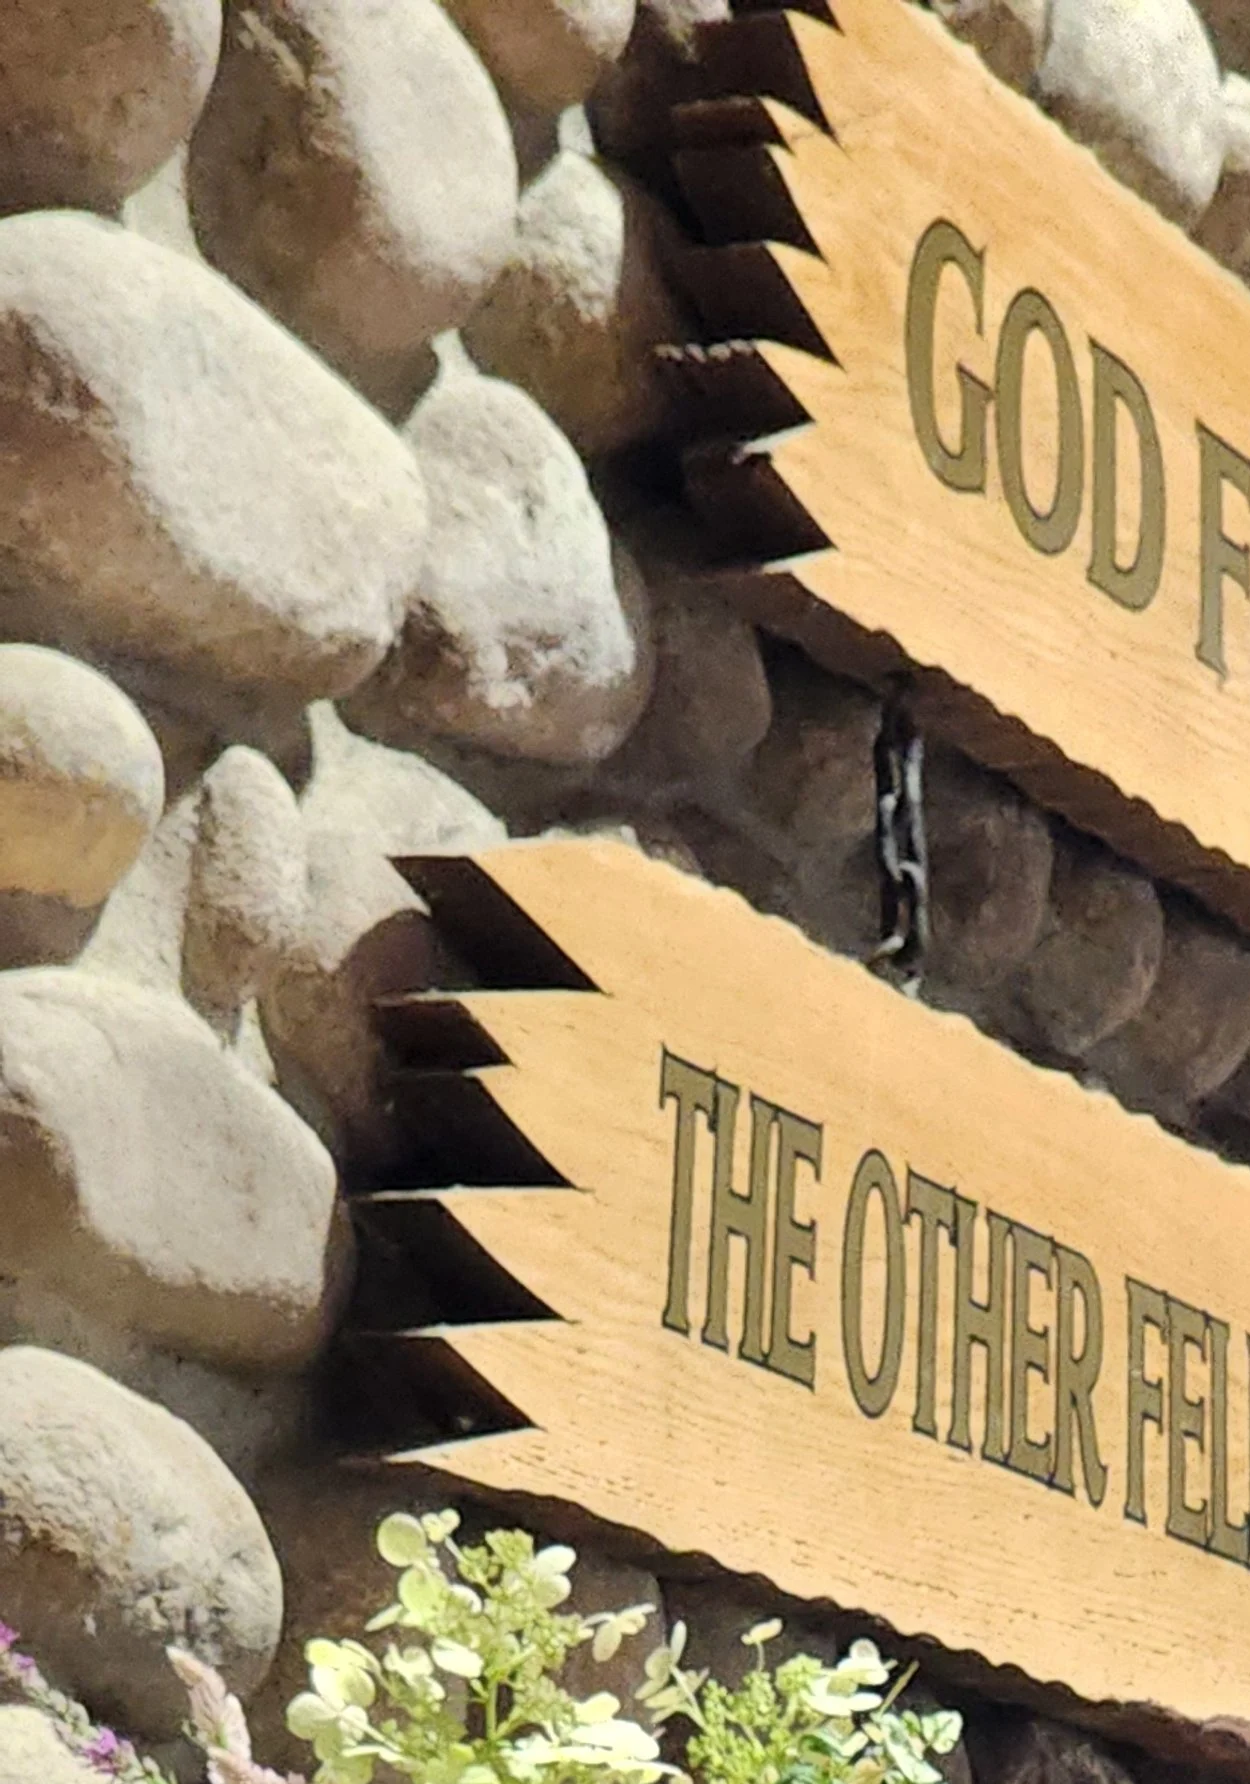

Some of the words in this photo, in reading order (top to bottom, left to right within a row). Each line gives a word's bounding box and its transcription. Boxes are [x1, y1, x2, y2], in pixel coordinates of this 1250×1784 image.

[904, 216, 1168, 613] GOD
[660, 1043, 824, 1392] THE
[841, 1147, 1108, 1507] OTHER
